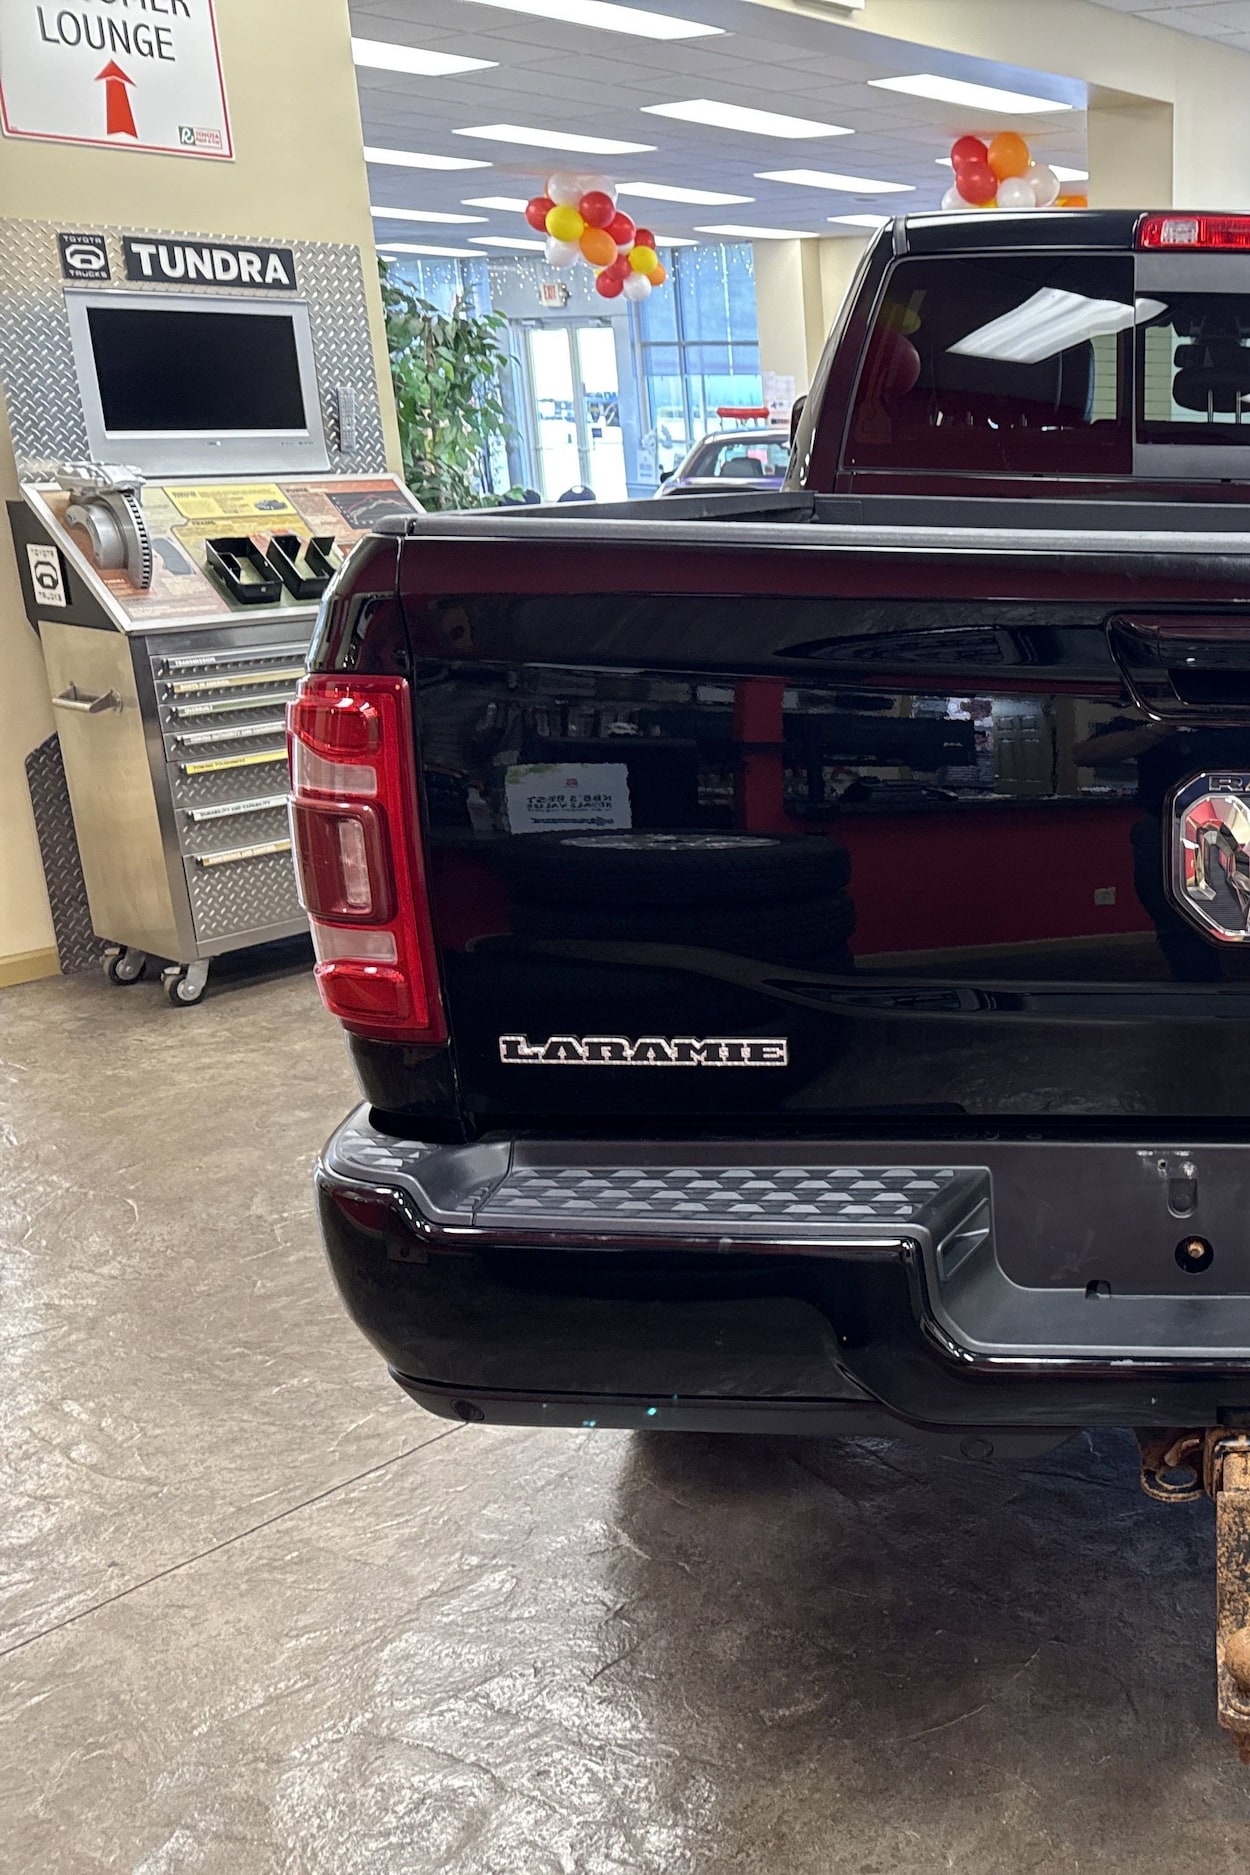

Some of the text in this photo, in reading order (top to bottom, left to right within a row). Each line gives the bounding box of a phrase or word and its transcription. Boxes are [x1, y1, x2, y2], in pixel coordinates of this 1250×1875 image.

[36, 5, 176, 62] LOUNGE
[63, 235, 102, 244] TOYOTA
[69, 270, 107, 279] TRUCKS
[130, 242, 290, 285] TUNDRA
[499, 1033, 789, 1067] LARAMIE
